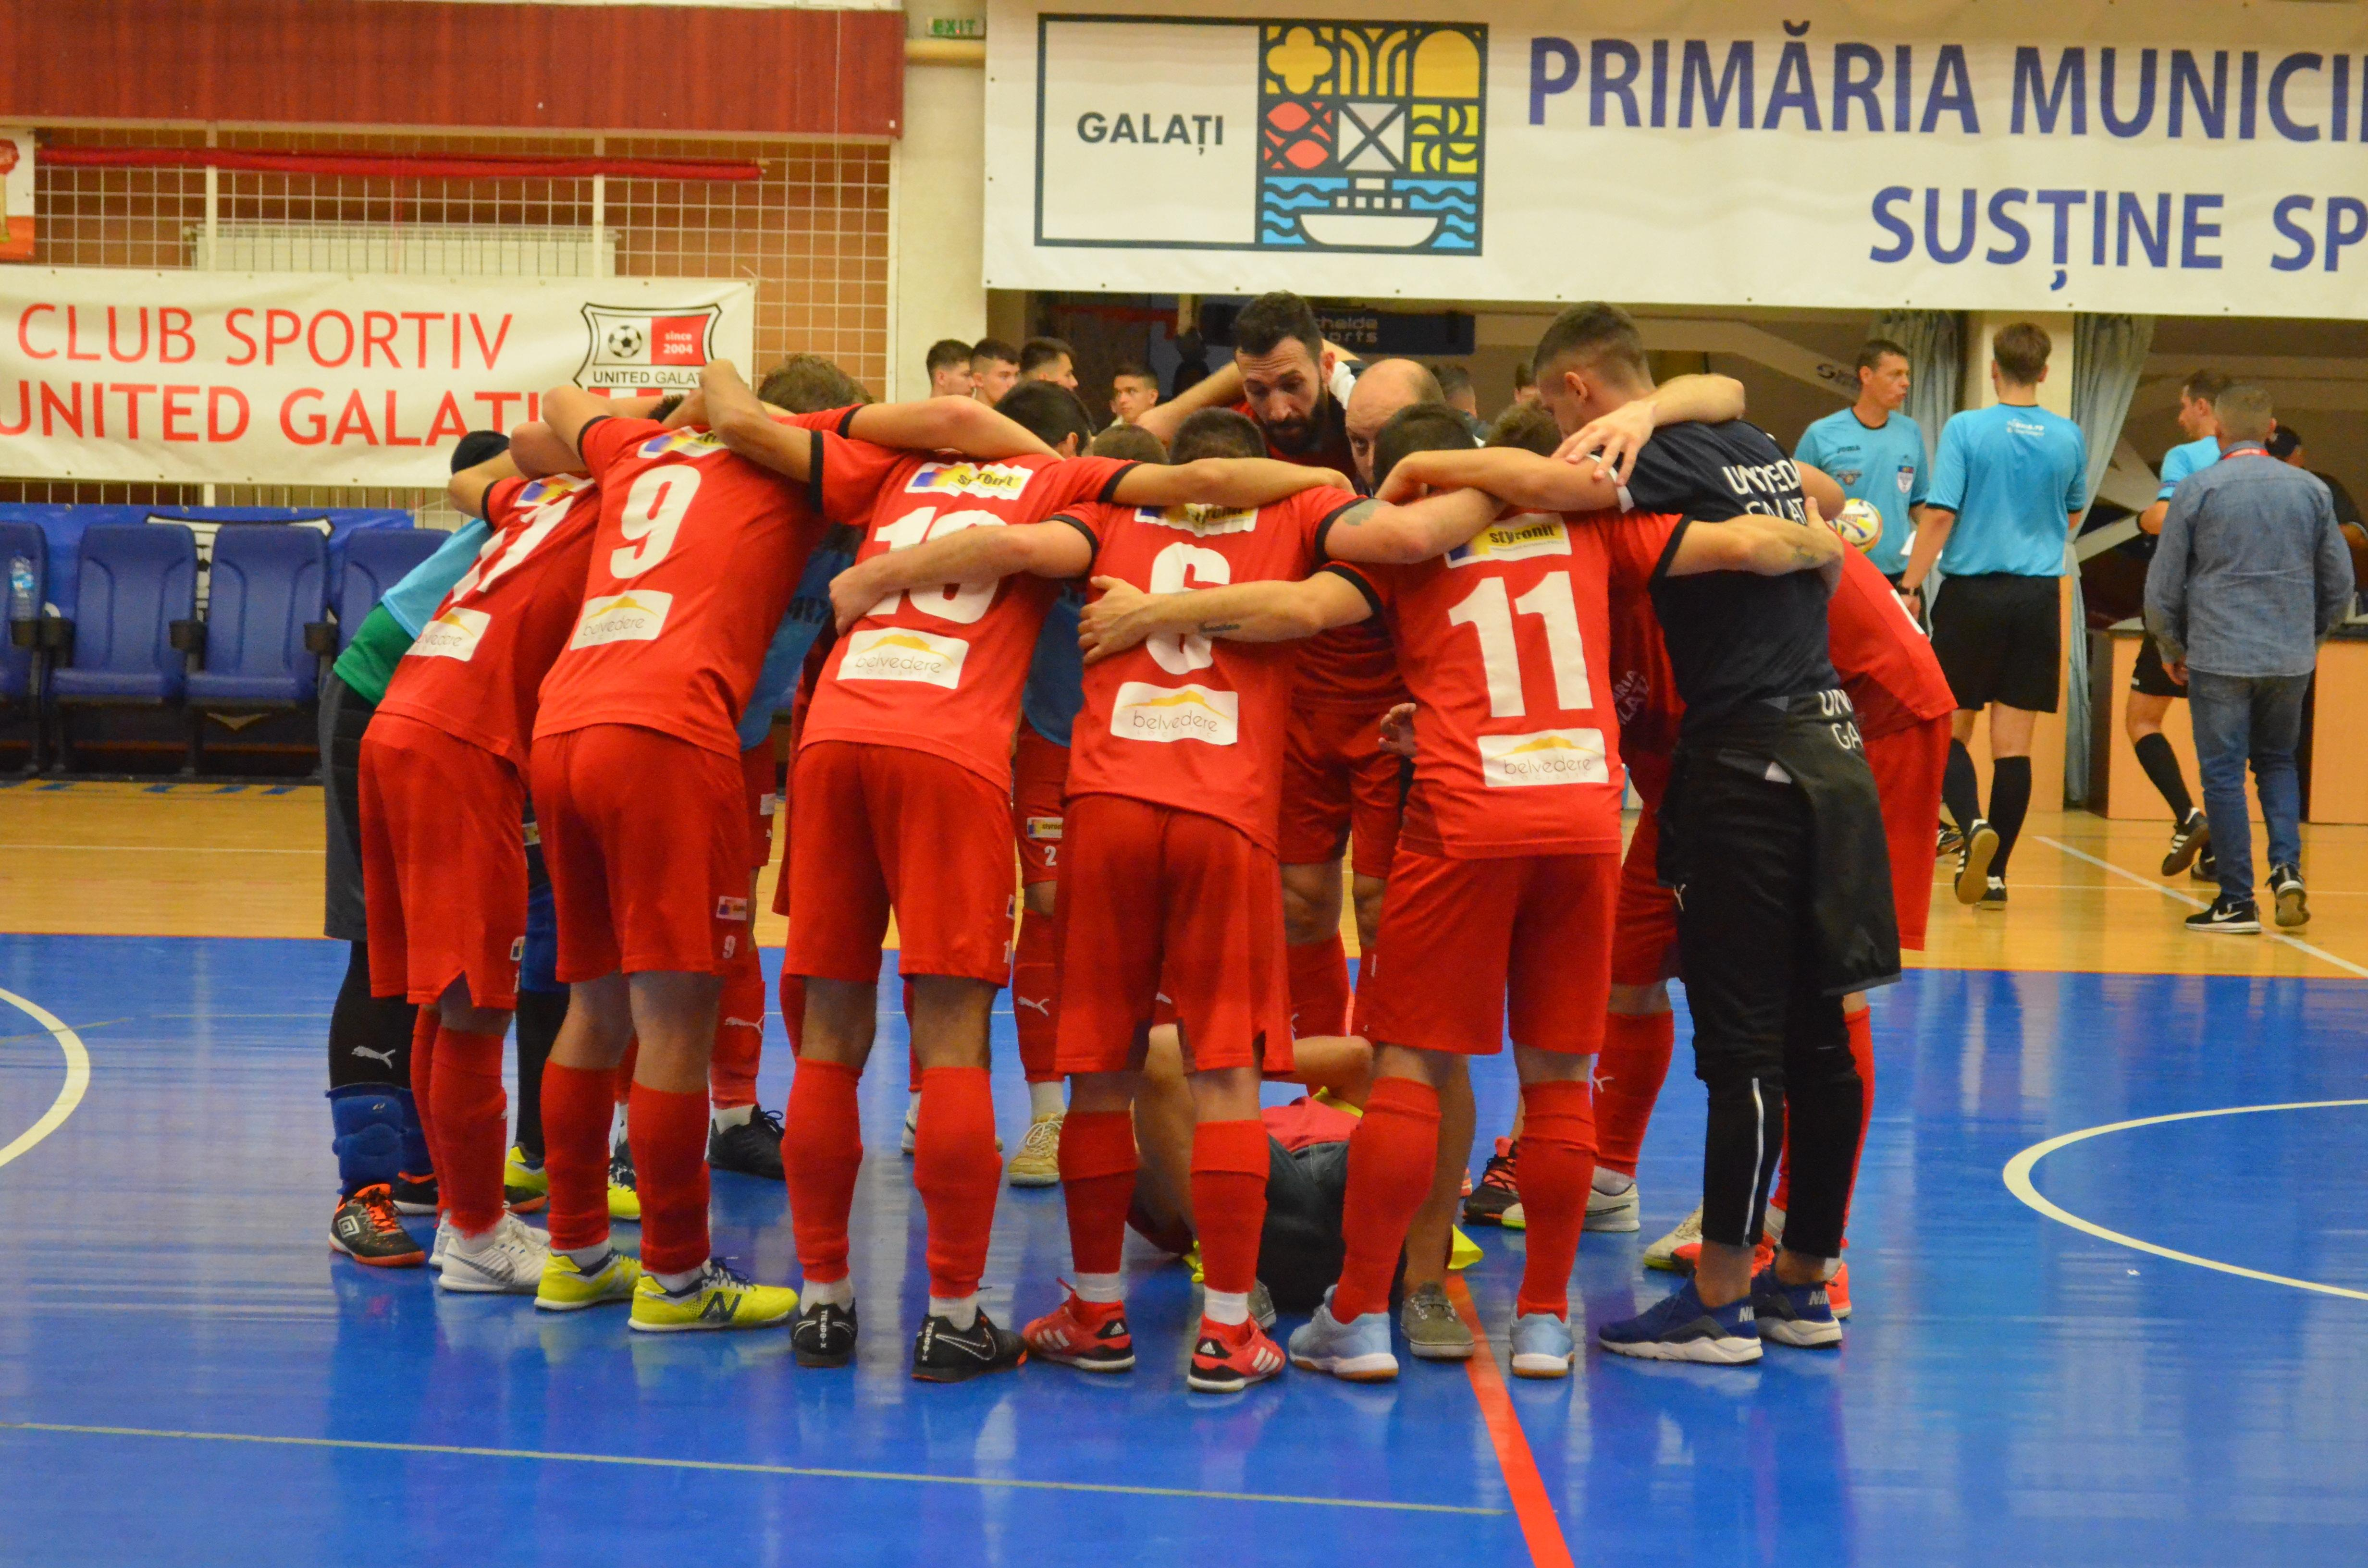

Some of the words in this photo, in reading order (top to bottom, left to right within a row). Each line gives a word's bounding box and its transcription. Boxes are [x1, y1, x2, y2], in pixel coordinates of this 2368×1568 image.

[1529, 20, 1980, 134] PRIMĂRIA
[2010, 46, 2368, 143] MUNICI
[1078, 112, 1223, 155] GALAȚI
[1870, 186, 2224, 291] SUSȚINE
[18, 303, 196, 363] CLUB
[225, 308, 512, 369] SPORTIV
[663, 344, 693, 354] 2004
[665, 331, 692, 341] since
[593, 371, 650, 383] UNITED
[655, 371, 700, 384] GALA
[0, 380, 250, 443] UNITED
[610, 465, 701, 579] 9
[1448, 571, 1593, 718] 11
[855, 652, 941, 673] belvedere
[1133, 710, 1217, 732] belvedere
[1504, 756, 1591, 775] belvedere
[722, 935, 737, 958] 9
